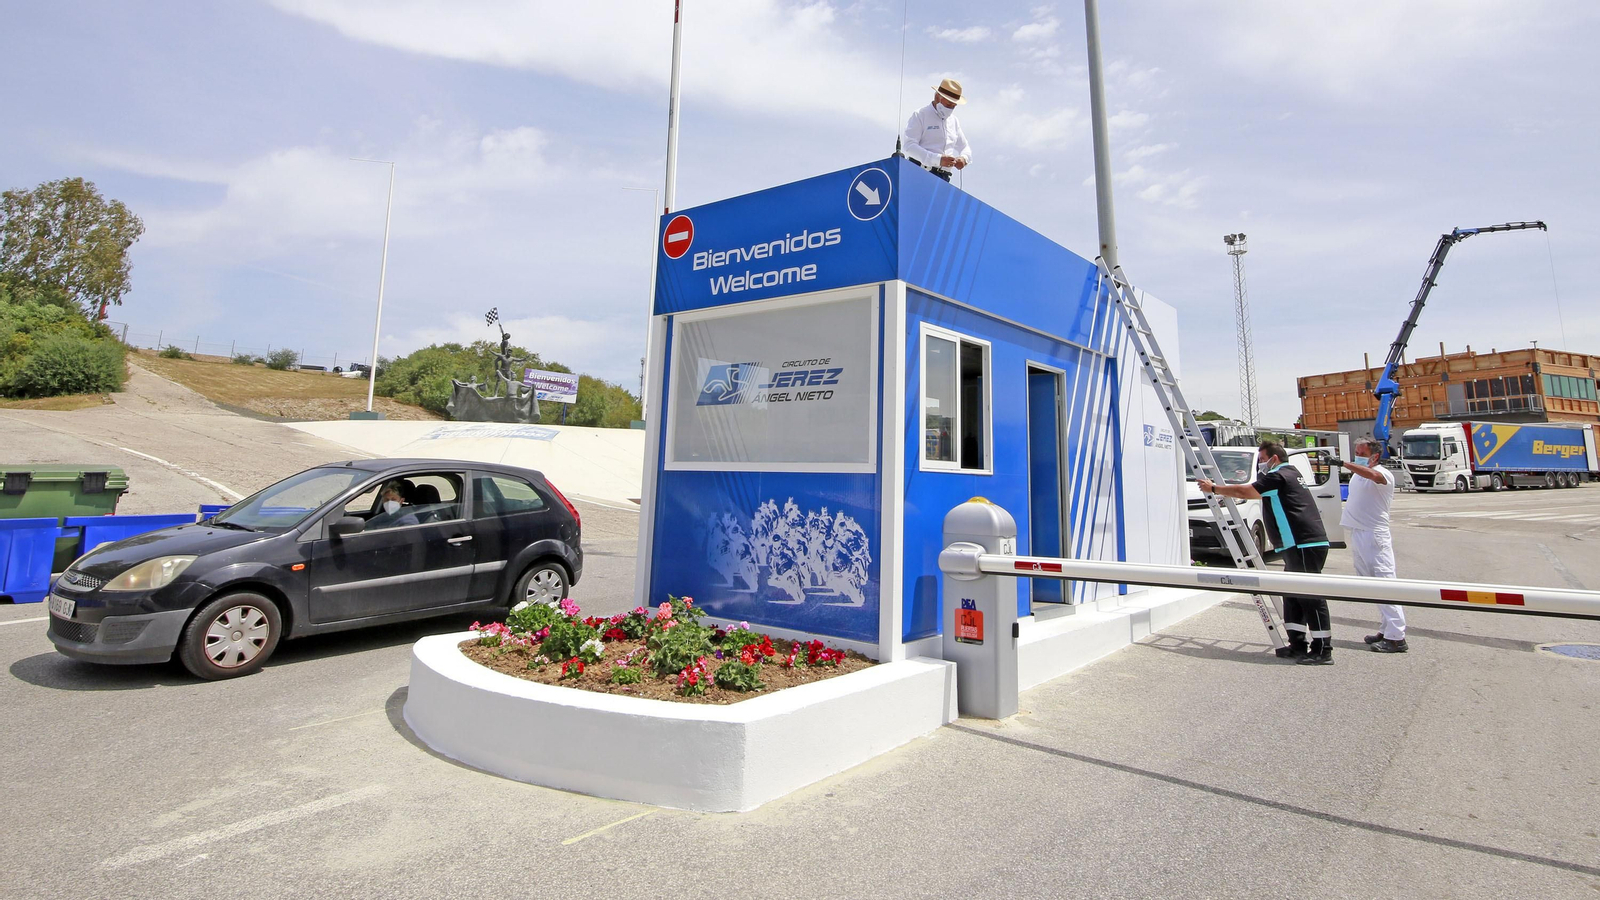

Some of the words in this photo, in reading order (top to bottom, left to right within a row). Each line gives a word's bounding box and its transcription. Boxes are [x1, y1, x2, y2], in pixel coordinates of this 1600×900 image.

[693, 228, 841, 271] Bienvenidos
[710, 264, 817, 295] Welcome
[782, 359, 818, 368] CIRCUITO
[529, 372, 575, 384] Bienvenidos
[758, 368, 844, 389] JEREZ
[534, 382, 569, 392] Welcome
[751, 392, 792, 403] ÁNGEL
[794, 390, 834, 402] NIETO
[1532, 440, 1585, 458] Berger
[961, 598, 976, 610] DEA
